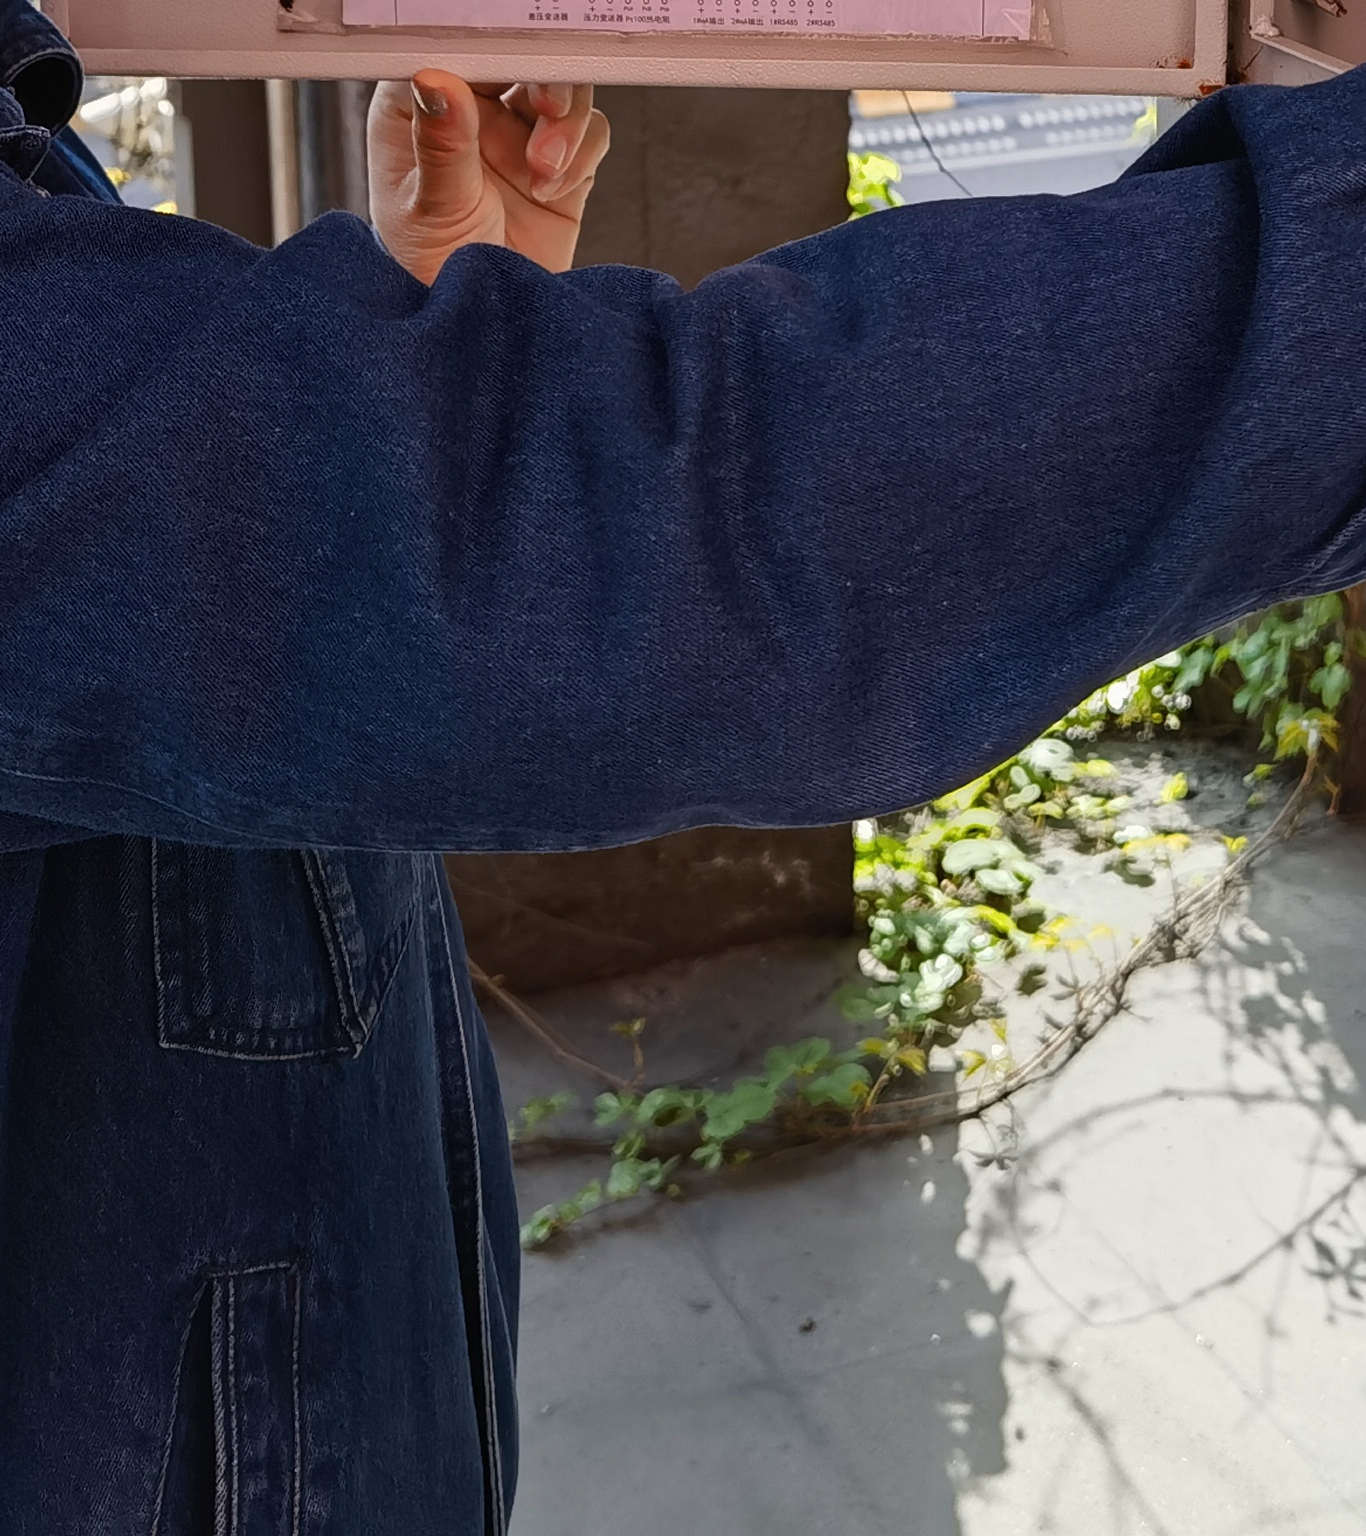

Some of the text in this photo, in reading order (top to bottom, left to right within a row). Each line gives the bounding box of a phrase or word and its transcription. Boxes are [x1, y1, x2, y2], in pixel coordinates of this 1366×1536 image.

[584, 13, 623, 22] 压力变送器
